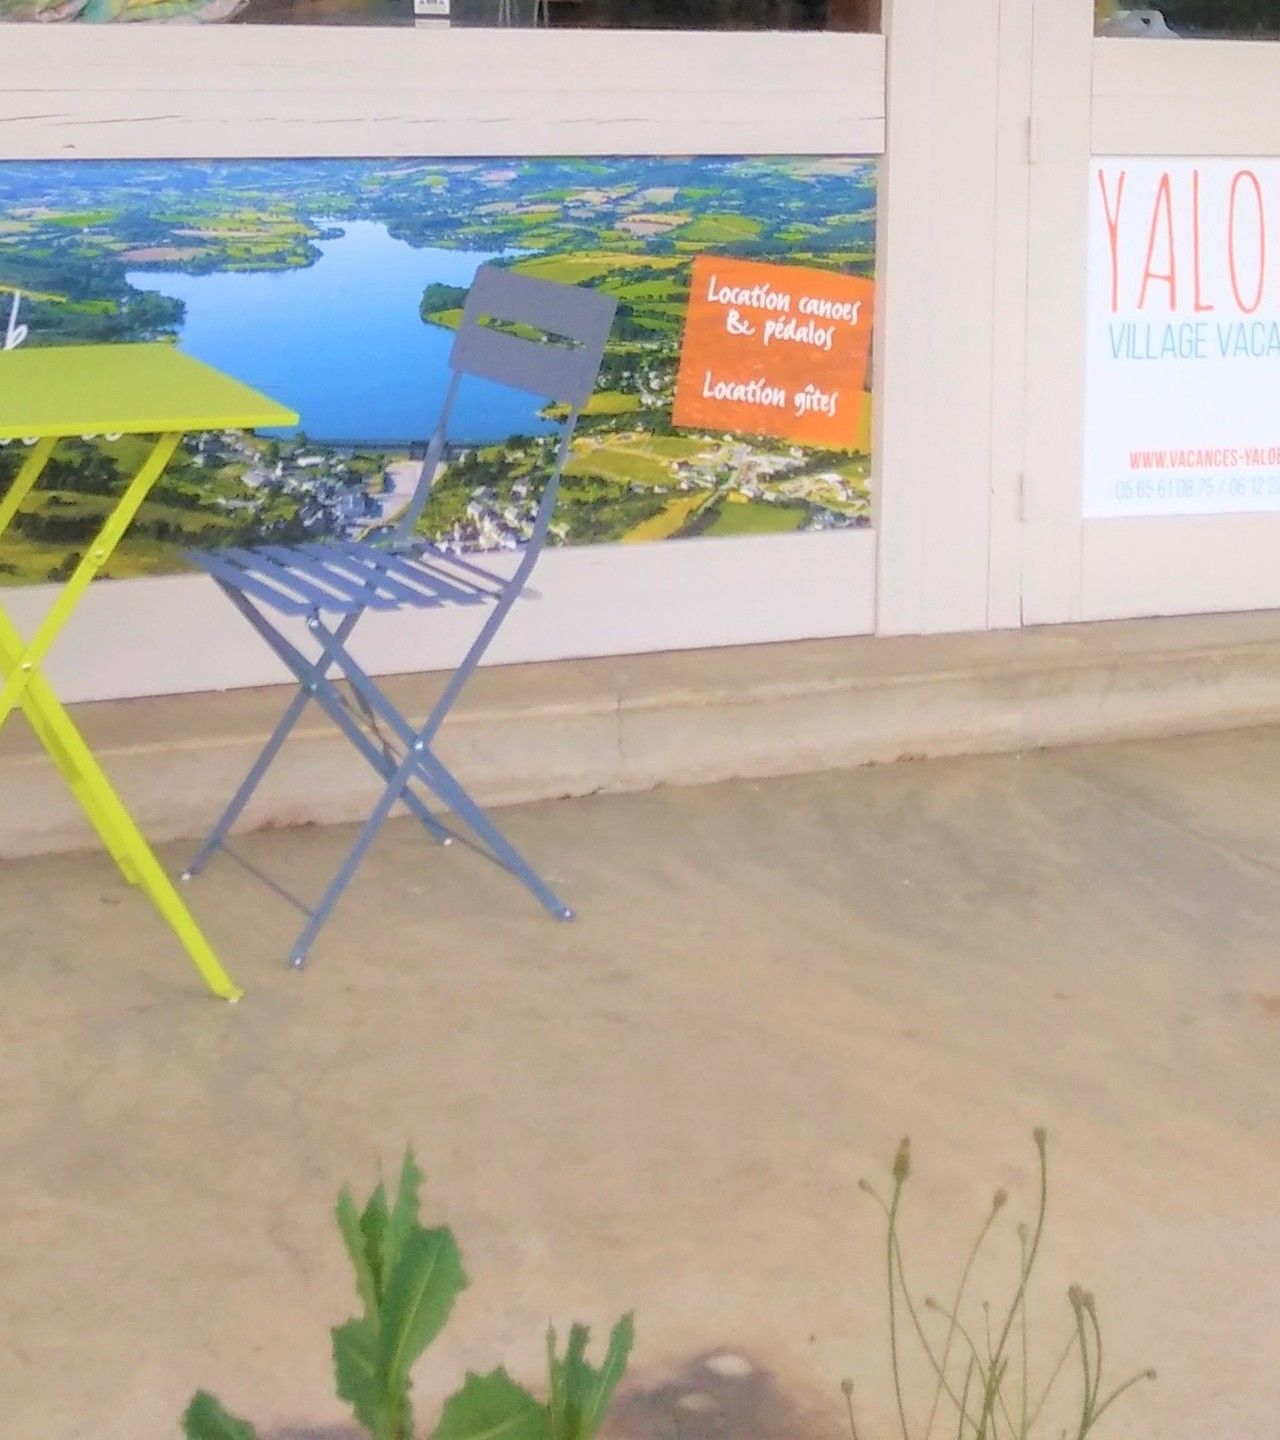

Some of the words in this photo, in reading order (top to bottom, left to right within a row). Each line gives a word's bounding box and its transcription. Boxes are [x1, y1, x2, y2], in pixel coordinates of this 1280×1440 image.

[708, 275, 791, 311] Location
[799, 296, 861, 326] canoes
[726, 309, 756, 336] &
[763, 315, 835, 351] pédalos
[1109, 322, 1208, 360] VILLAGE
[703, 371, 786, 407] Location
[794, 384, 839, 417] gîtes
